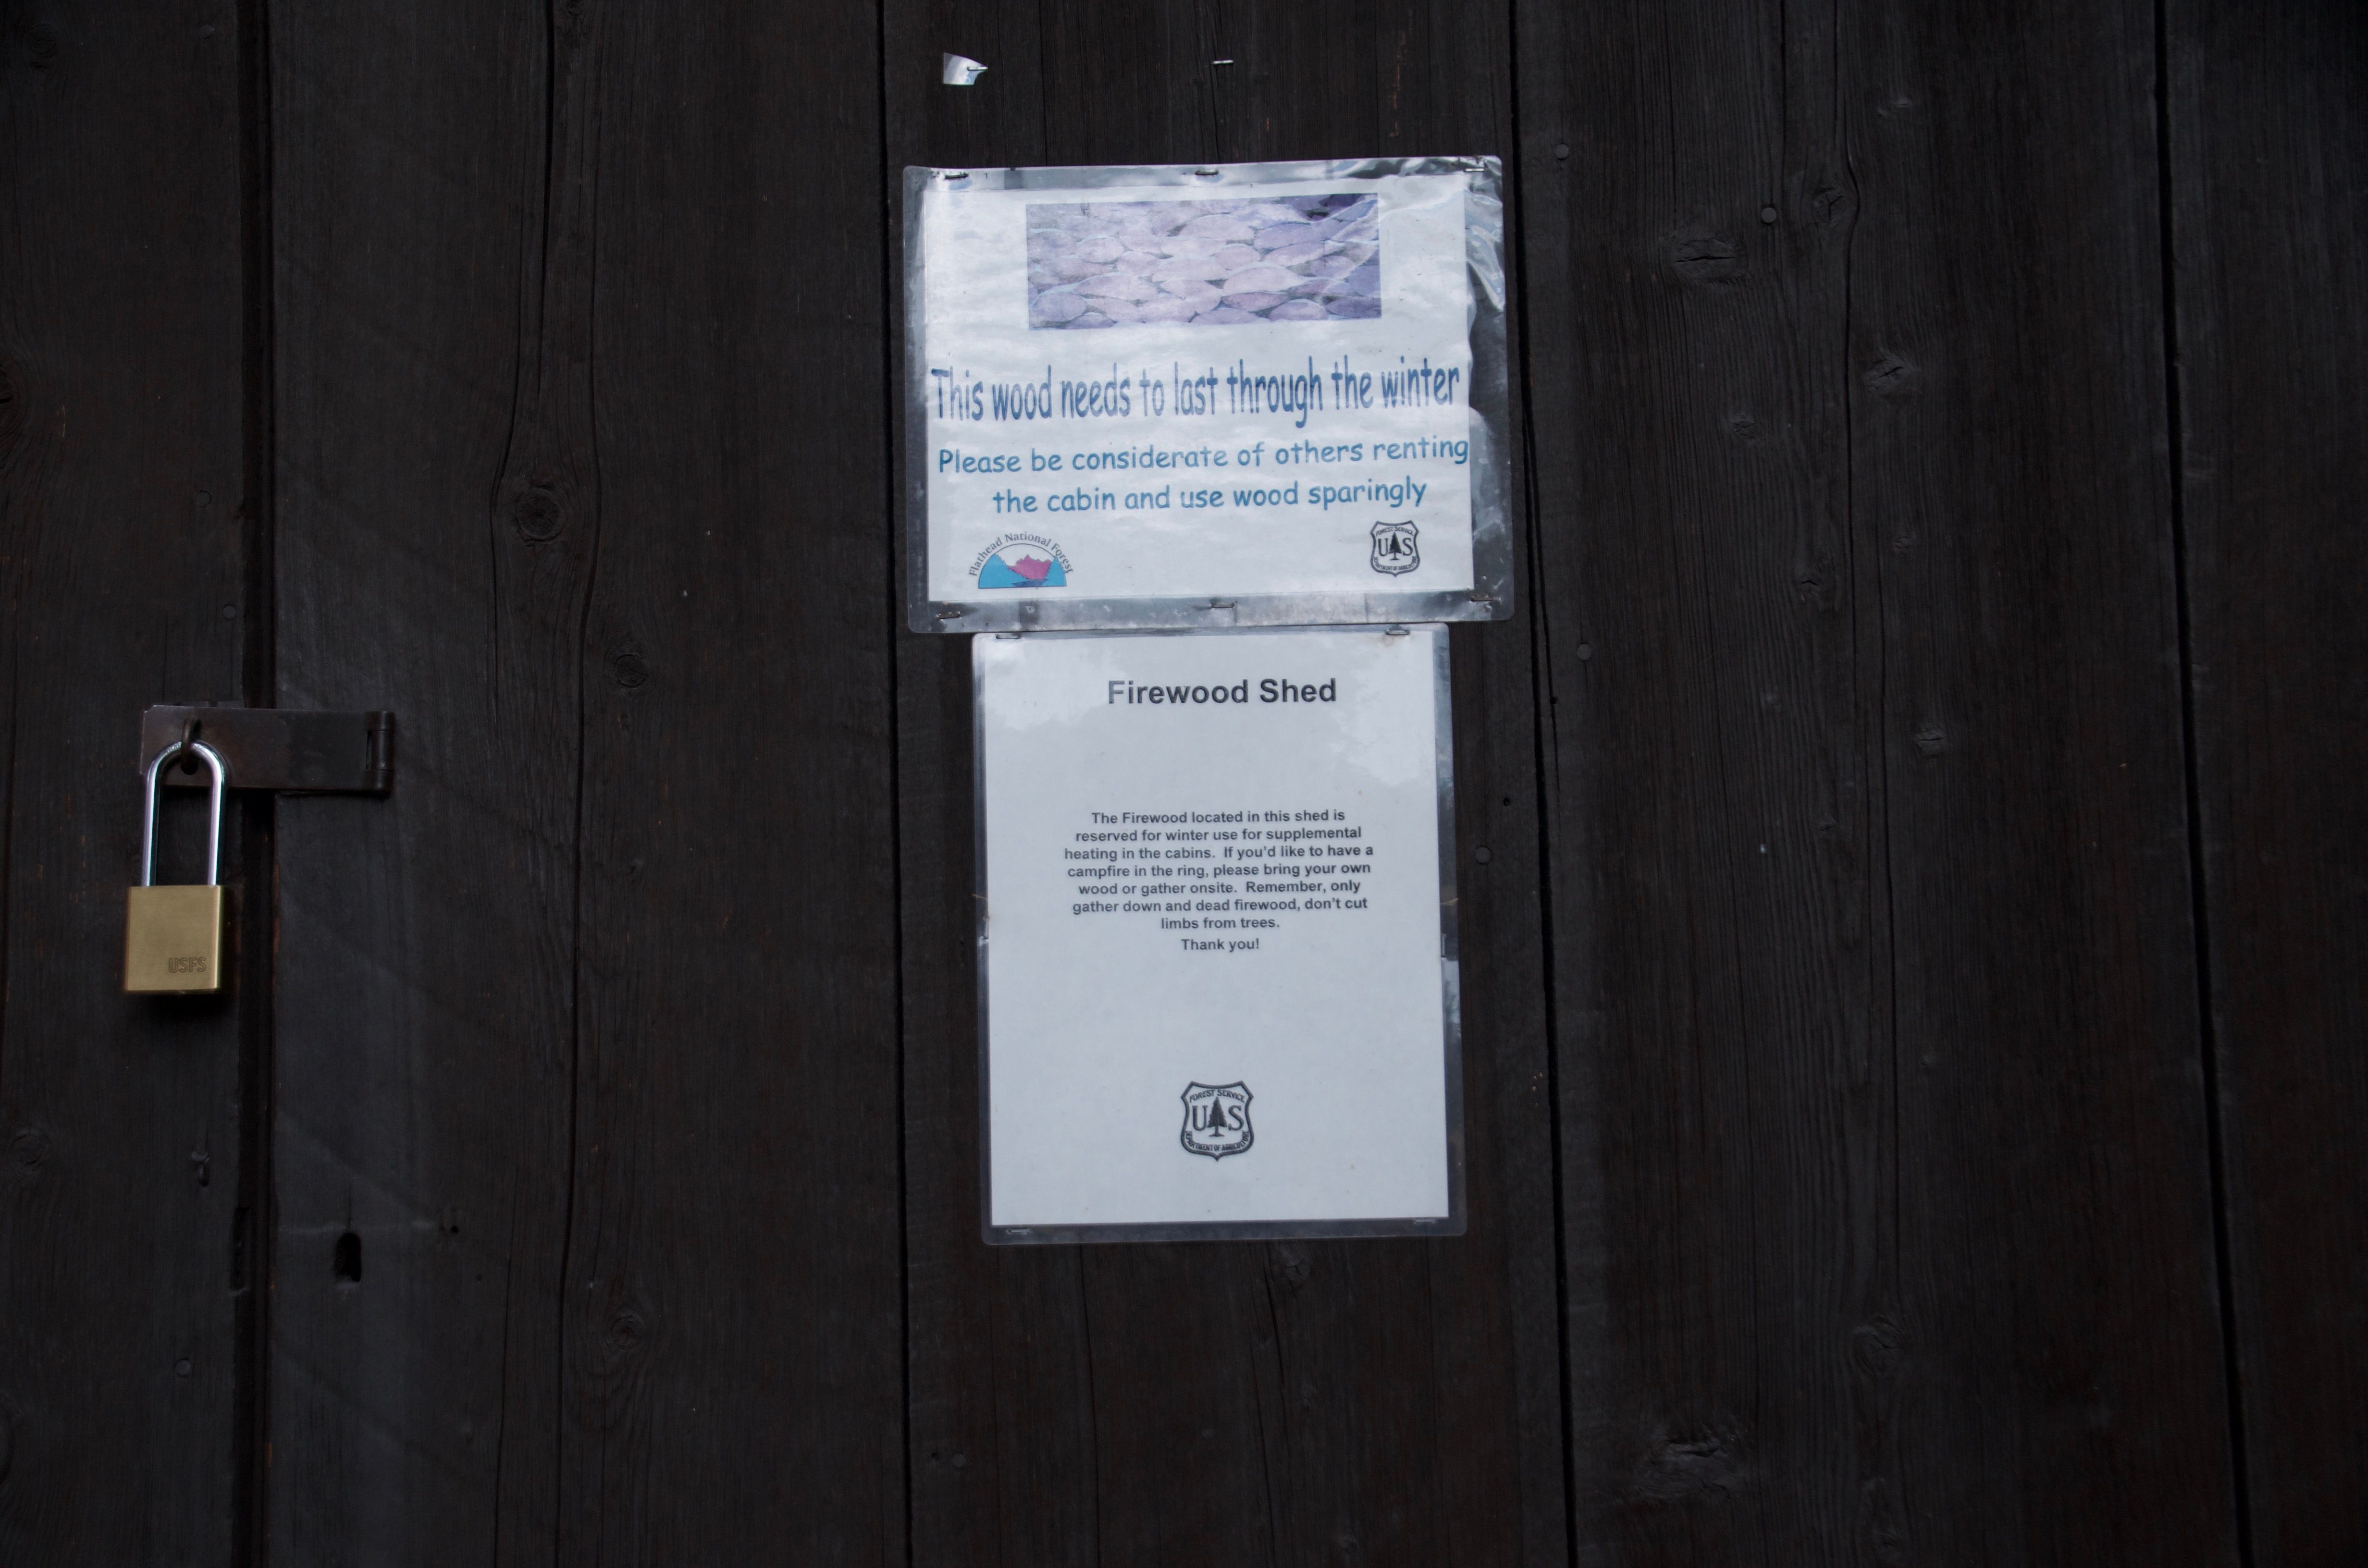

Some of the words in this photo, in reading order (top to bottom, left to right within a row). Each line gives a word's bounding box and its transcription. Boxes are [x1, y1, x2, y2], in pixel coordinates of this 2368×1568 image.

[930, 366, 984, 421] This
[992, 364, 1052, 421] wood
[1060, 362, 1131, 418] needs
[1139, 369, 1165, 417] to
[1174, 361, 1219, 416] last
[1226, 355, 1323, 428] through
[1331, 354, 1374, 410] the
[1381, 355, 1460, 408] winter
[939, 449, 1022, 473] Please
[1031, 448, 1063, 472] be
[1072, 444, 1229, 470] considerate
[1237, 441, 1265, 467] of
[1274, 439, 1363, 465] others
[1373, 435, 1468, 465] renting
[992, 488, 1038, 514] the
[1047, 487, 1116, 512] cabin
[1124, 484, 1171, 510] and
[1180, 489, 1224, 508] use
[1233, 480, 1299, 507] wood
[1308, 475, 1427, 510] sparingly
[969, 537, 1003, 576] Flathead
[1005, 531, 1052, 547] National
[1051, 543, 1074, 574] Forest
[1109, 679, 1248, 704] Firewood
[1259, 678, 1336, 703] Shed
[1091, 812, 1118, 824] The
[1122, 811, 1187, 824] Firewood
[1192, 810, 1243, 823] located
[1247, 810, 1260, 822] in
[1264, 810, 1290, 822] this
[1295, 809, 1329, 821] shed
[1333, 809, 1345, 821] is
[1076, 830, 1137, 842] reserved
[1141, 829, 1162, 841] for
[1165, 829, 1209, 841] winter
[1213, 831, 1238, 841] use
[1242, 828, 1262, 840] for
[1266, 826, 1361, 842] supplemental
[1064, 847, 1118, 862] heating
[1122, 847, 1135, 859] in
[1138, 847, 1161, 859] the
[1165, 847, 1215, 859] cabins.
[1224, 846, 1233, 858] If
[1237, 845, 1276, 860] you'd
[1281, 845, 1305, 857] like
[1309, 845, 1323, 857] to
[1327, 845, 1361, 856] have
[1365, 846, 1374, 856] a
[1067, 865, 1130, 880] campfire
[1134, 865, 1147, 877] in
[1151, 865, 1173, 877] the
[1177, 864, 1209, 879] ring,
[1213, 864, 1259, 878] please
[1264, 863, 1300, 878] bring
[1305, 865, 1337, 877] your
[1341, 864, 1371, 874] own
[1078, 882, 1118, 894] wood
[1122, 885, 1137, 894] or
[1141, 882, 1186, 897] gather
[1190, 882, 1237, 894] onsite.
[1246, 880, 1326, 894] Remember,
[1330, 879, 1361, 894] only
[1073, 900, 1119, 915] gather
[1122, 900, 1161, 912] down
[1165, 899, 1191, 912] and
[1196, 899, 1230, 911] dead
[1234, 898, 1300, 912] firewood,
[1304, 897, 1341, 910] don't
[1344, 897, 1368, 909] cut
[1161, 917, 1199, 929] limbs
[1203, 917, 1236, 929] from
[1240, 918, 1280, 928] trees.
[1181, 938, 1225, 950] Thank
[1229, 938, 1259, 953] you!
[168, 956, 207, 973] USFS
[1189, 1090, 1216, 1103] FOREST
[1217, 1089, 1246, 1103] SERVICE
